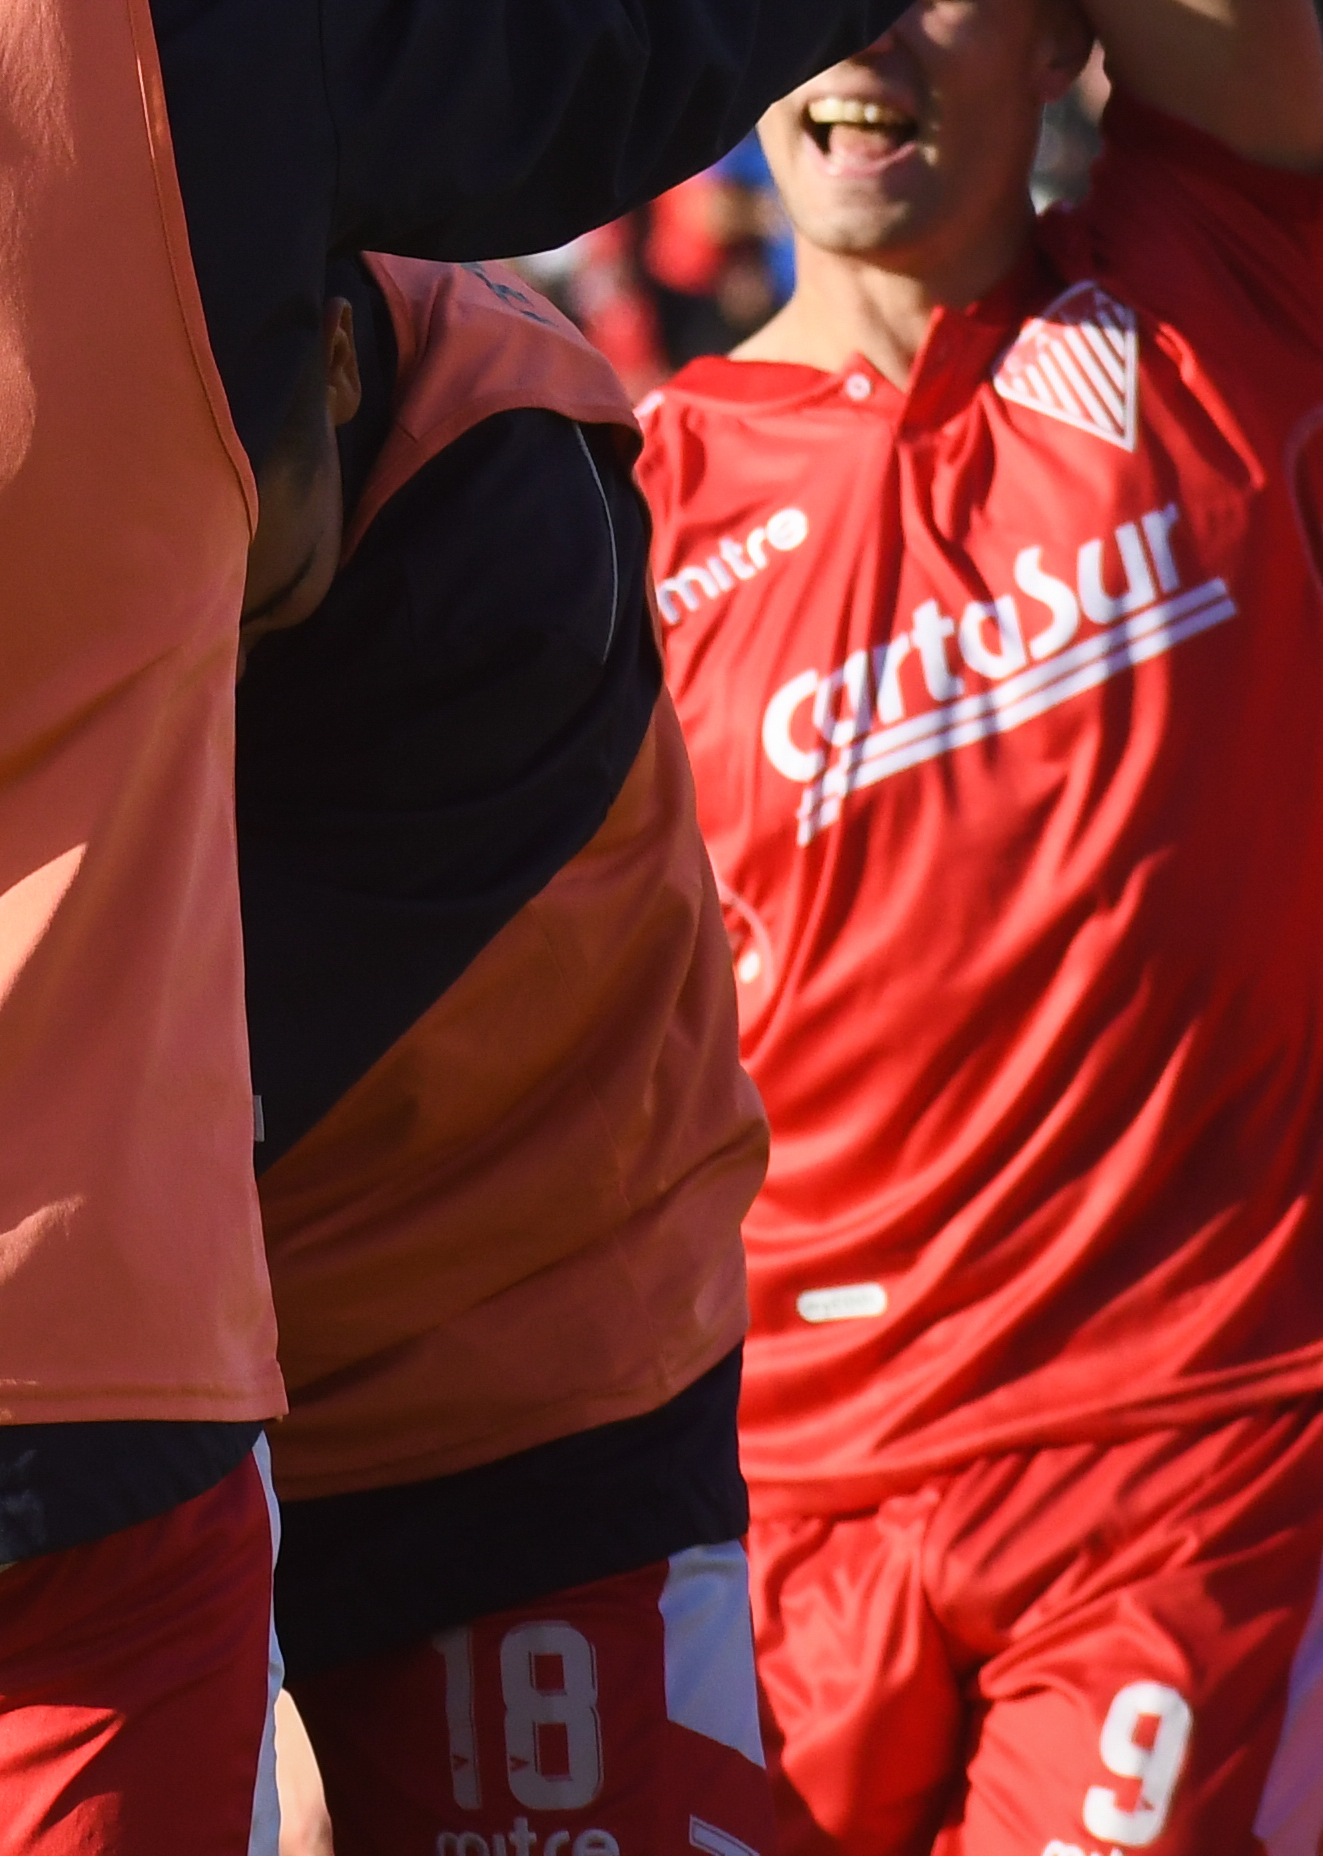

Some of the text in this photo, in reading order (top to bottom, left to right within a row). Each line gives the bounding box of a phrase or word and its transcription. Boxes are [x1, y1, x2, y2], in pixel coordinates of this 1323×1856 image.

[657, 507, 809, 626] mitre
[762, 502, 1180, 783] CartaSur
[432, 1619, 605, 1811] 18
[1082, 1679, 1194, 1848] 9
